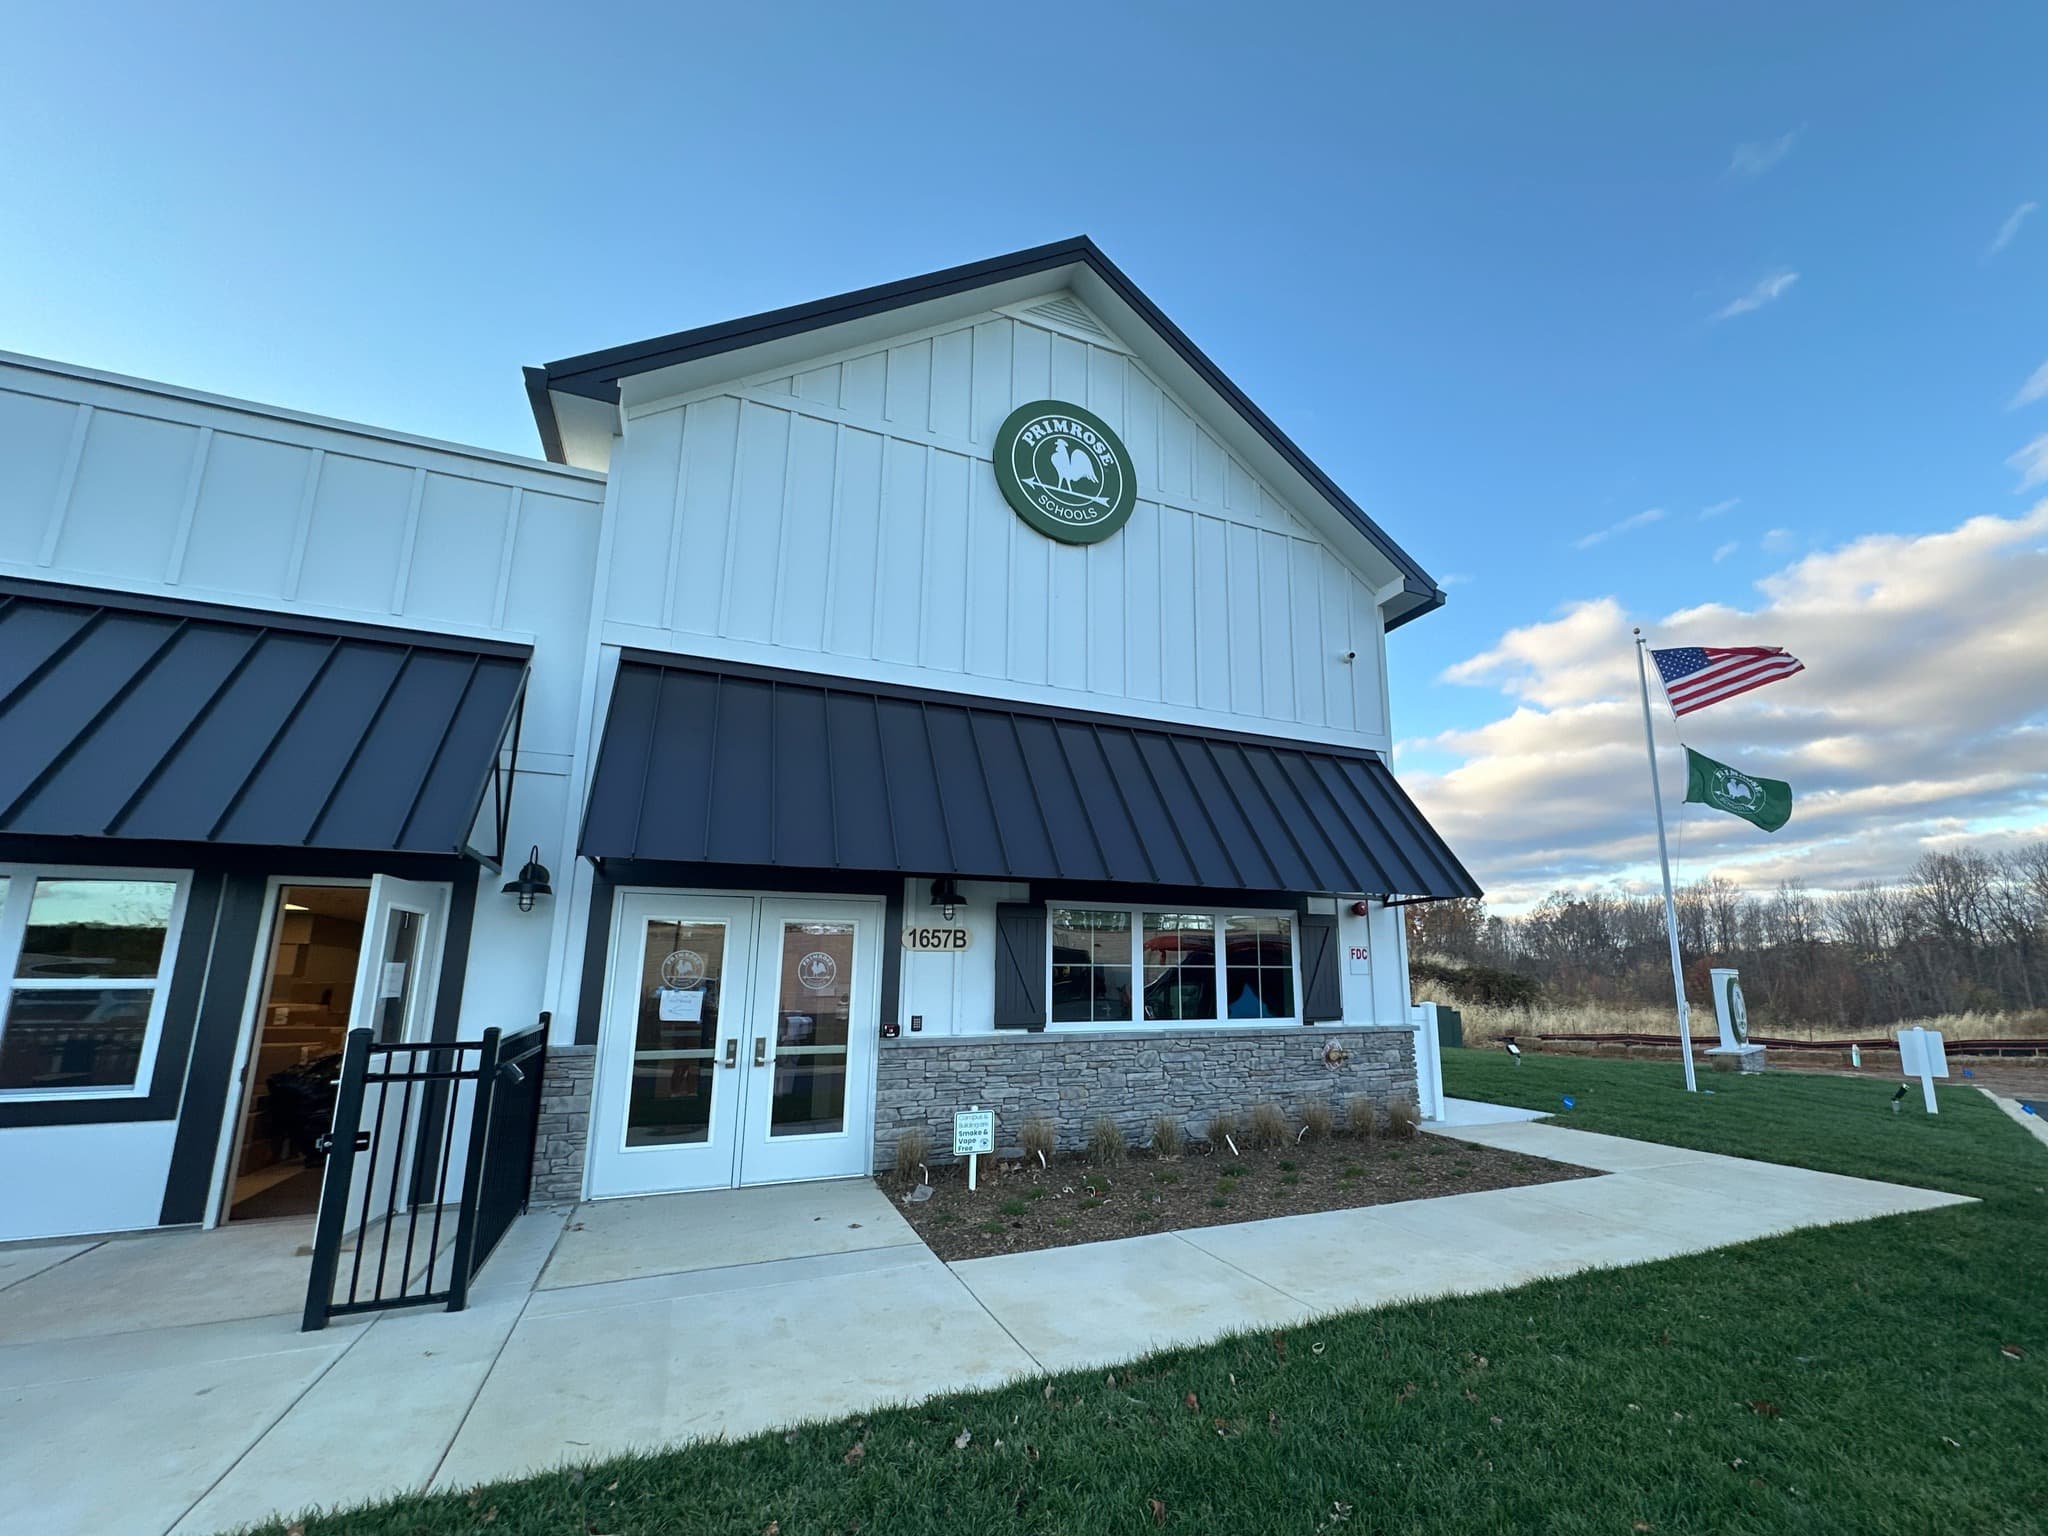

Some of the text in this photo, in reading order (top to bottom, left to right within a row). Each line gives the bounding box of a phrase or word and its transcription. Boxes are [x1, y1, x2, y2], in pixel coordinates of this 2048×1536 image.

[1022, 419, 1114, 467] PRIMROSE
[1038, 494, 1098, 521] SCHOOLS
[908, 928, 967, 949] 1657B
[1350, 948, 1368, 960] FDC
[958, 1128, 989, 1137] Smoke &
[958, 1137, 977, 1146] Vape
